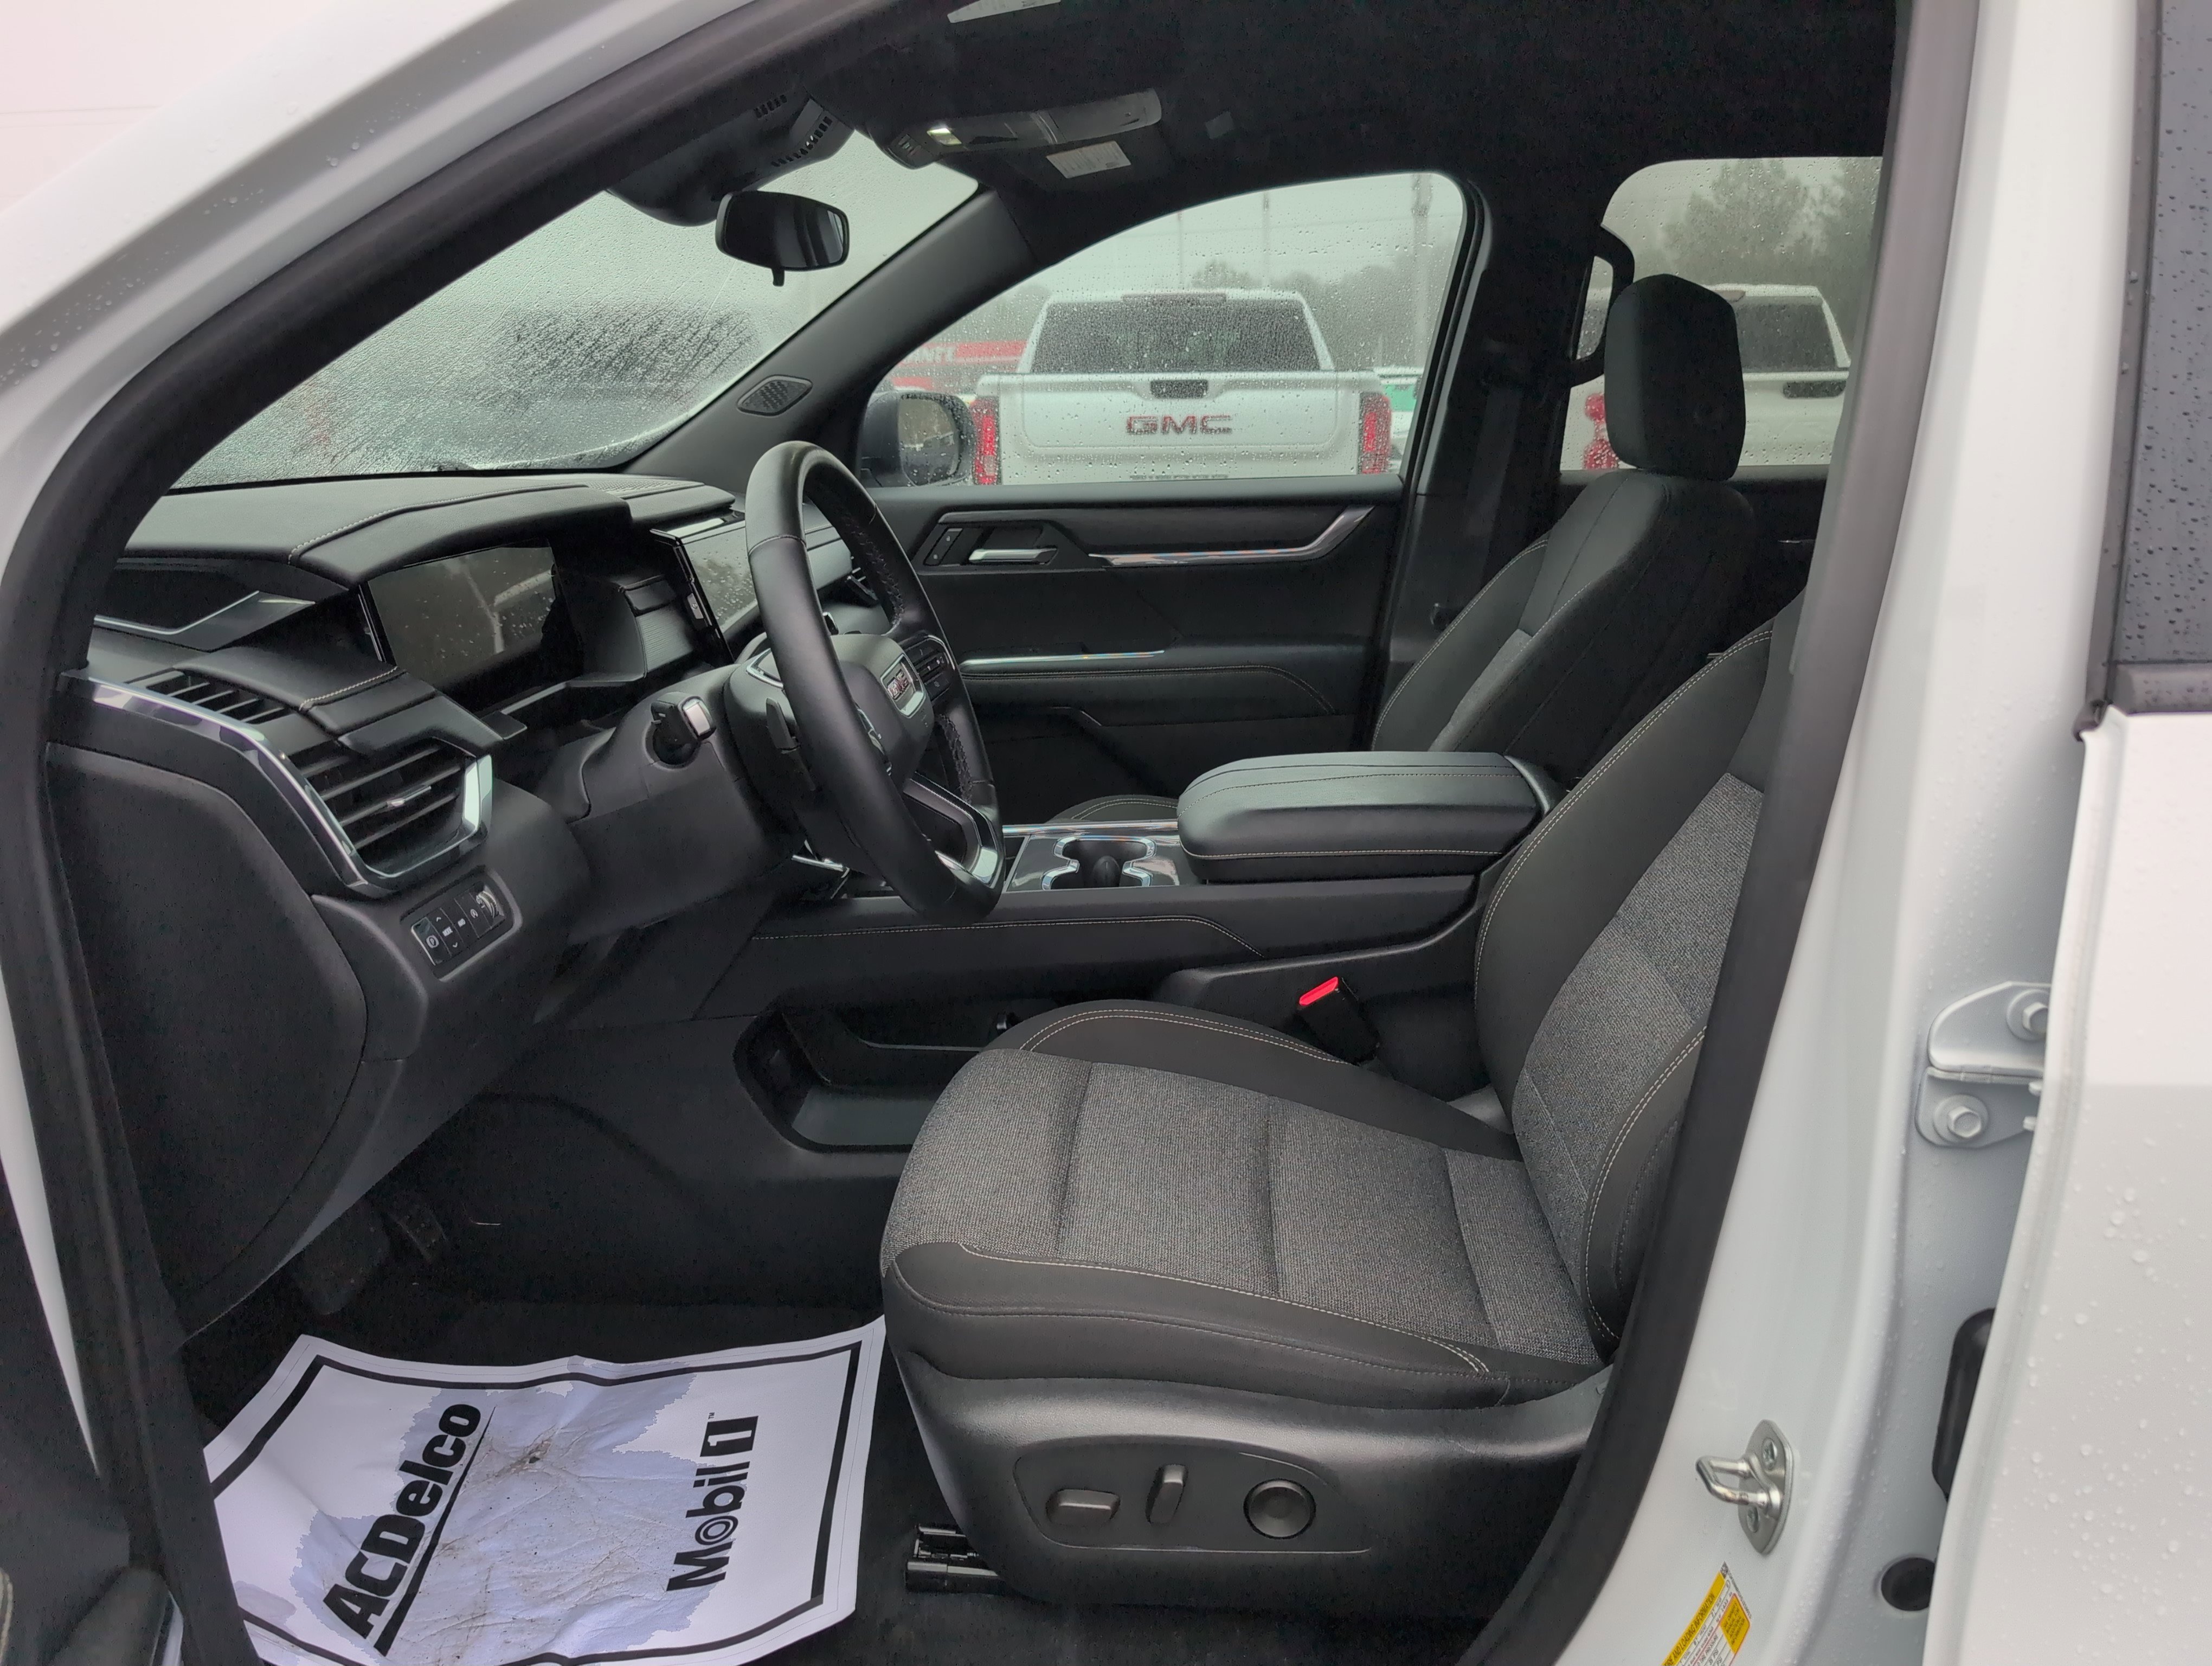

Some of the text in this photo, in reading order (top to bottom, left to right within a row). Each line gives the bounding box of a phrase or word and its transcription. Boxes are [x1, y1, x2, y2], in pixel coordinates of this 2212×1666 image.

[1127, 415, 1231, 434] GMC
[323, 1404, 481, 1639] ACDelco
[666, 1461, 750, 1592] Mobil
